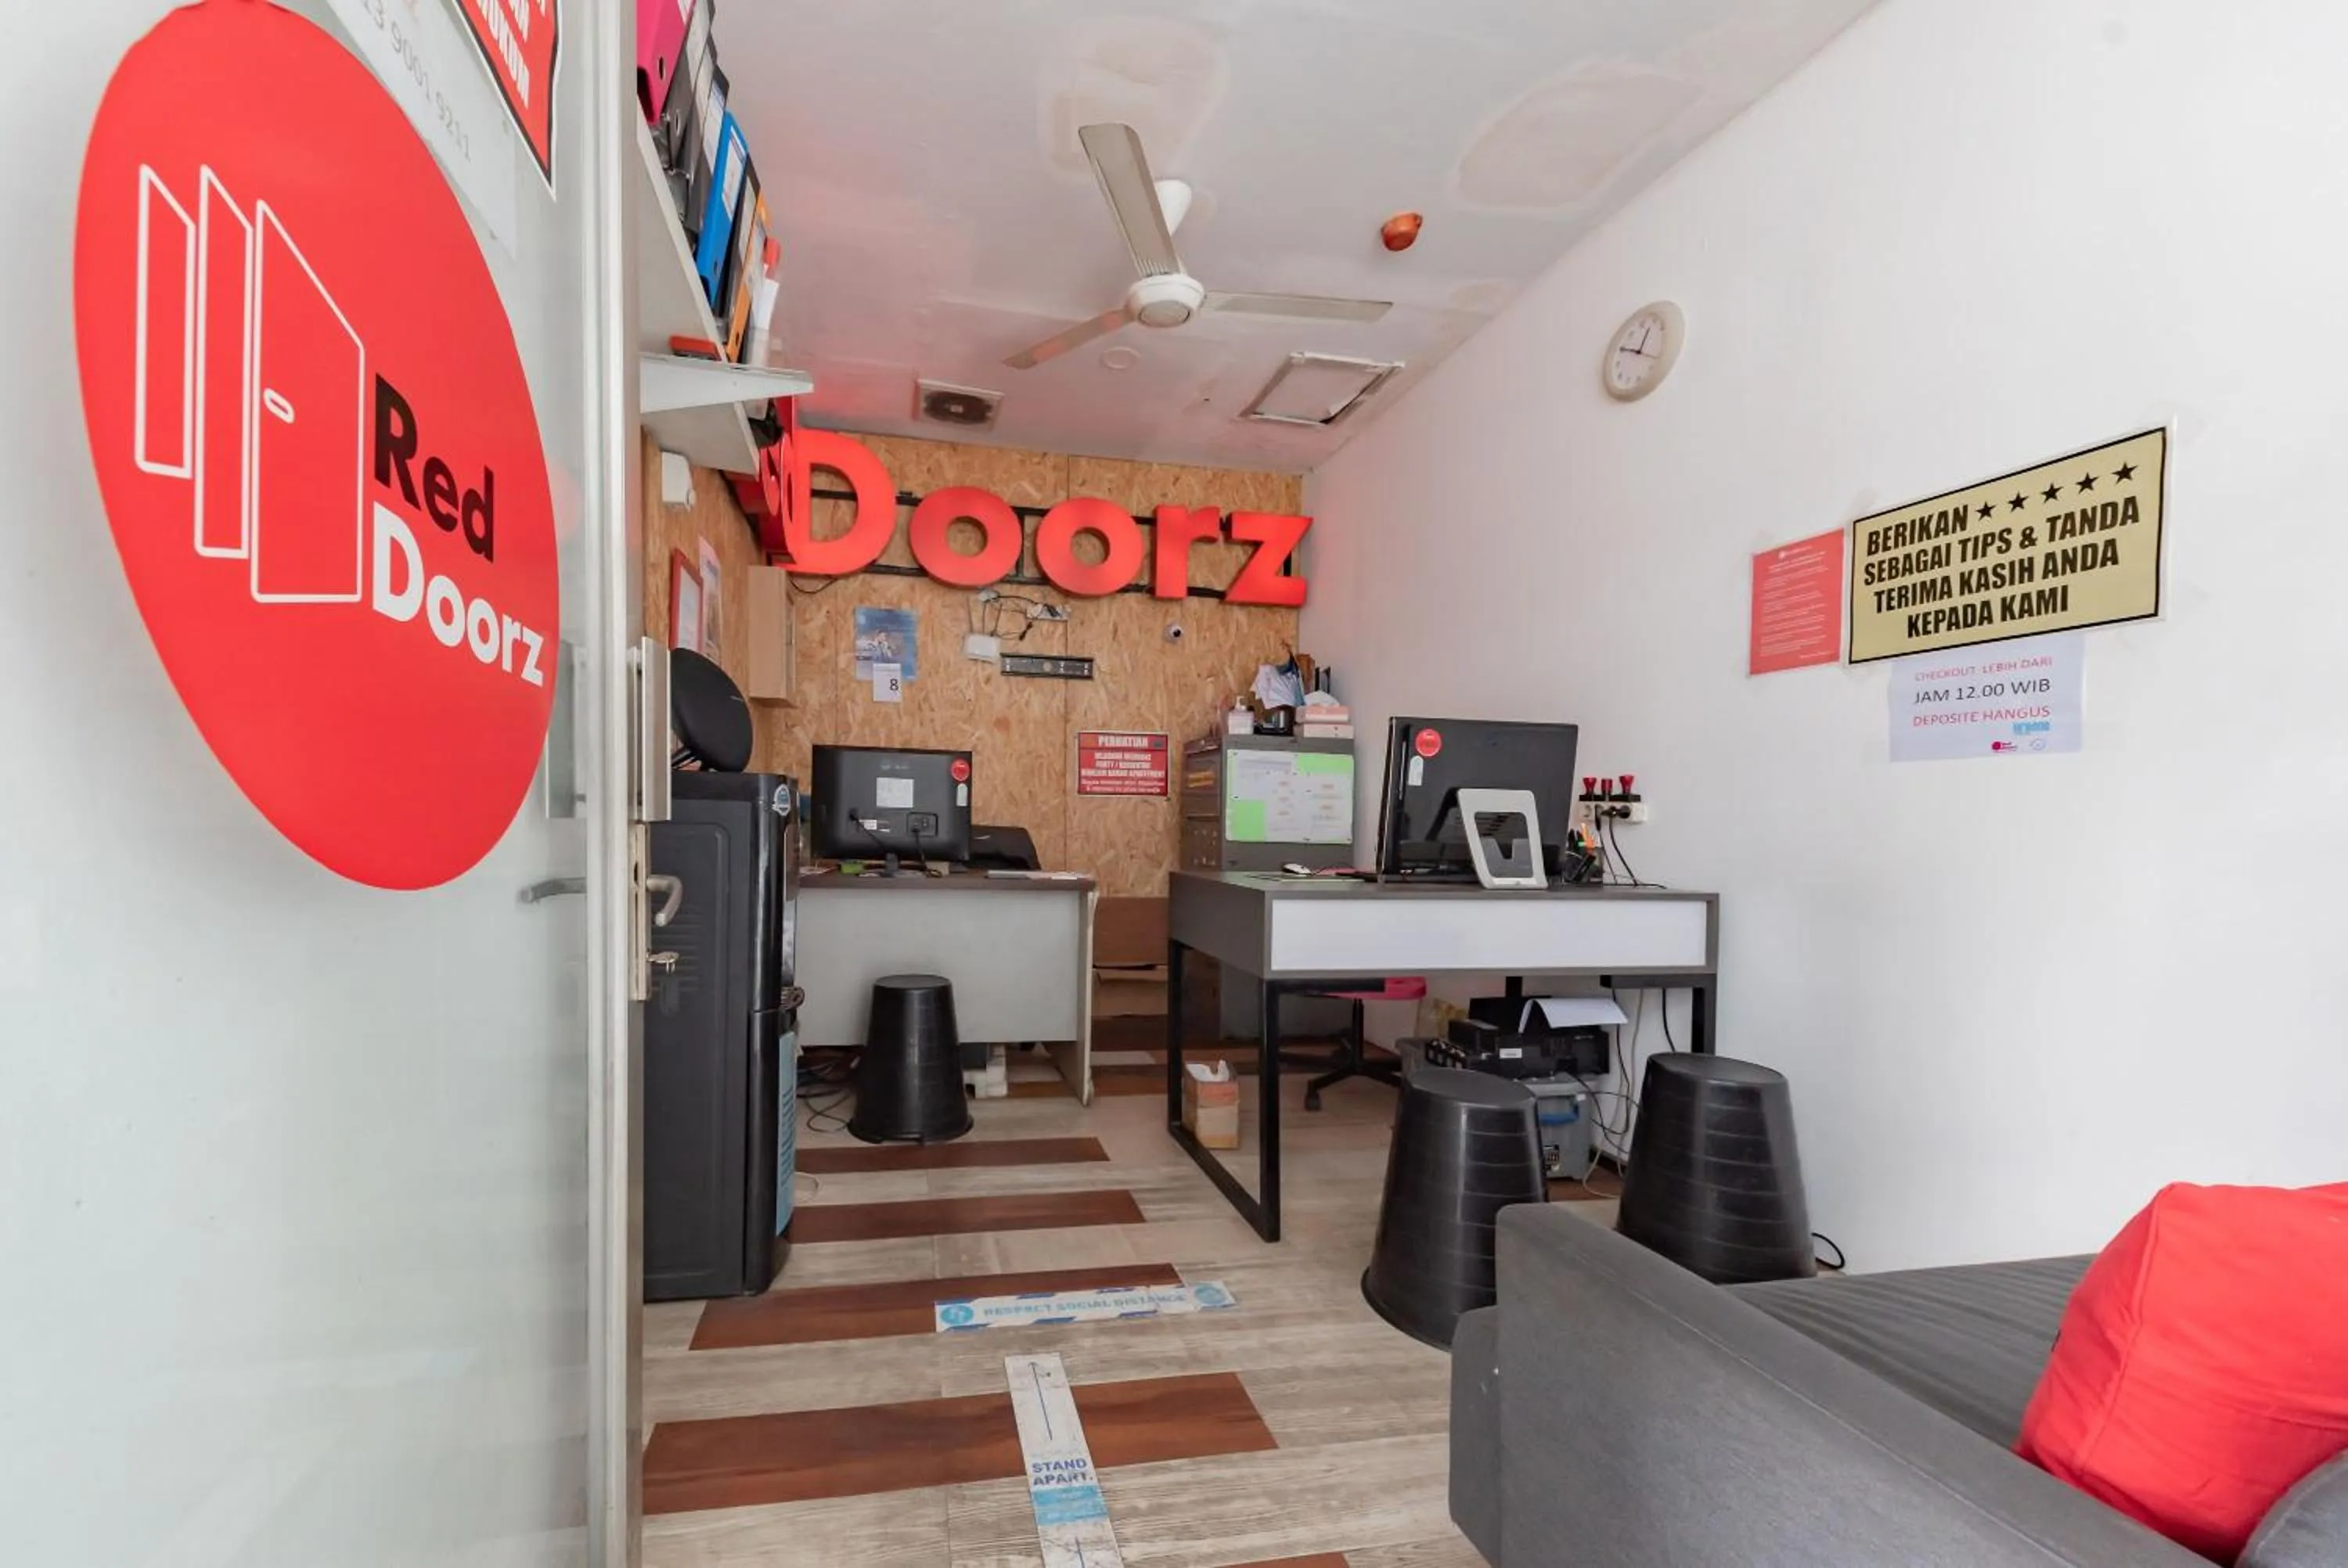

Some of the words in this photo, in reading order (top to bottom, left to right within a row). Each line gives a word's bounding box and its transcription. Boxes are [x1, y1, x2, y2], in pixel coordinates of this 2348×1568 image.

[374, 372, 494, 563] Red
[785, 428, 1313, 607] Doorz
[1864, 542, 1952, 586] SEBAGAI
[1958, 527, 2012, 563] TIPS
[2018, 526, 2038, 550] &
[2046, 495, 2140, 543] TANDA
[1867, 505, 1968, 556] BERIKAN
[373, 501, 545, 687] Doorz
[1874, 575, 1953, 614] TERIMA
[1959, 556, 2035, 596] KASIH
[2041, 538, 2119, 581] ANDA
[1907, 600, 1993, 638] KEPADA
[2000, 584, 2069, 622] KAMI
[890, 678, 899, 691] 8
[1914, 689, 1950, 704] JAM
[1956, 683, 2004, 700] 12.00
[2011, 678, 2051, 694] WIB
[1982, 663, 2017, 674] LEBIH
[2021, 656, 2053, 668] DARI
[1914, 710, 1979, 727] DEPOSITE
[1982, 705, 2051, 721] HANGUS
[1032, 1458, 1087, 1473] STAND
